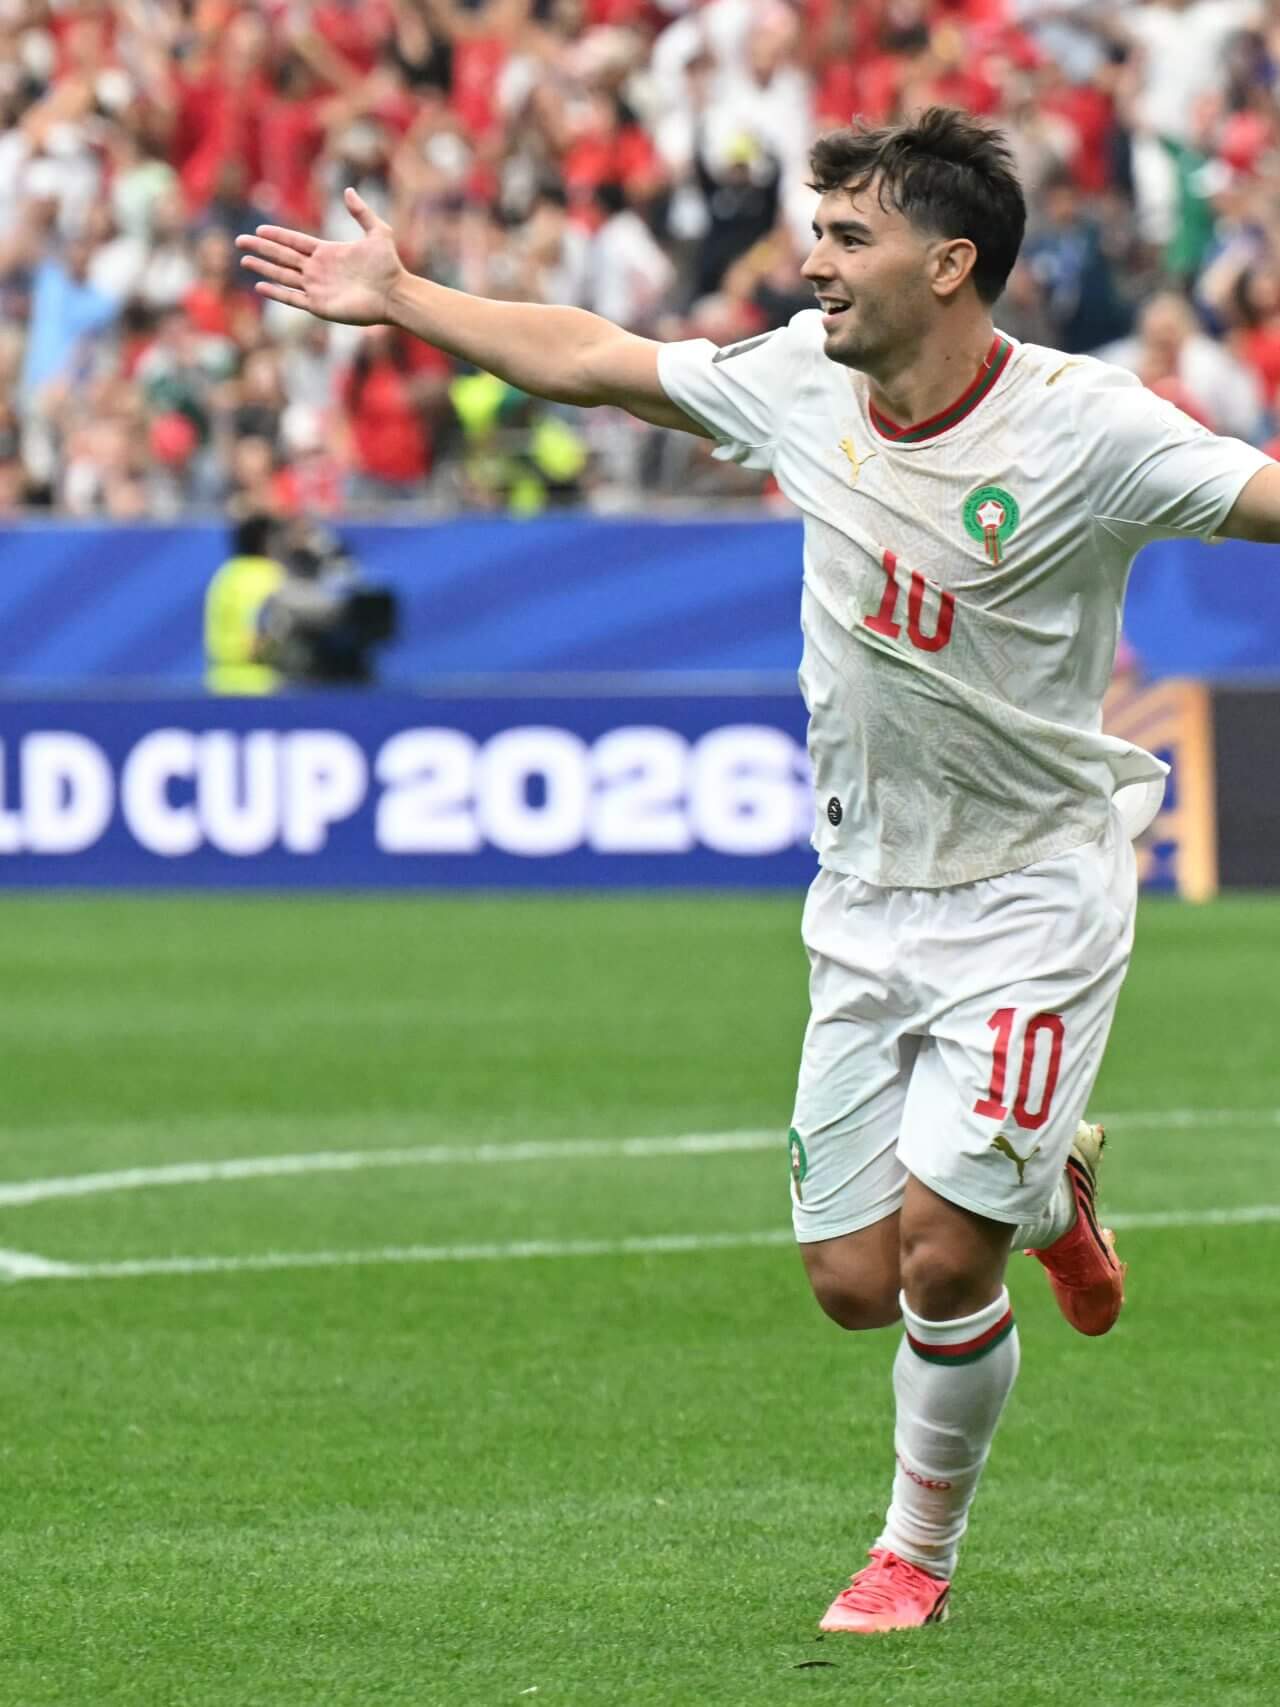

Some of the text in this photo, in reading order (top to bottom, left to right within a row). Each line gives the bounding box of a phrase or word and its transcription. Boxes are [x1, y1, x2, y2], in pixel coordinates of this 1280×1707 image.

[863, 549, 955, 652] 10
[0, 726, 803, 855] D CUP 2026
[973, 1007, 1065, 1130] 10
